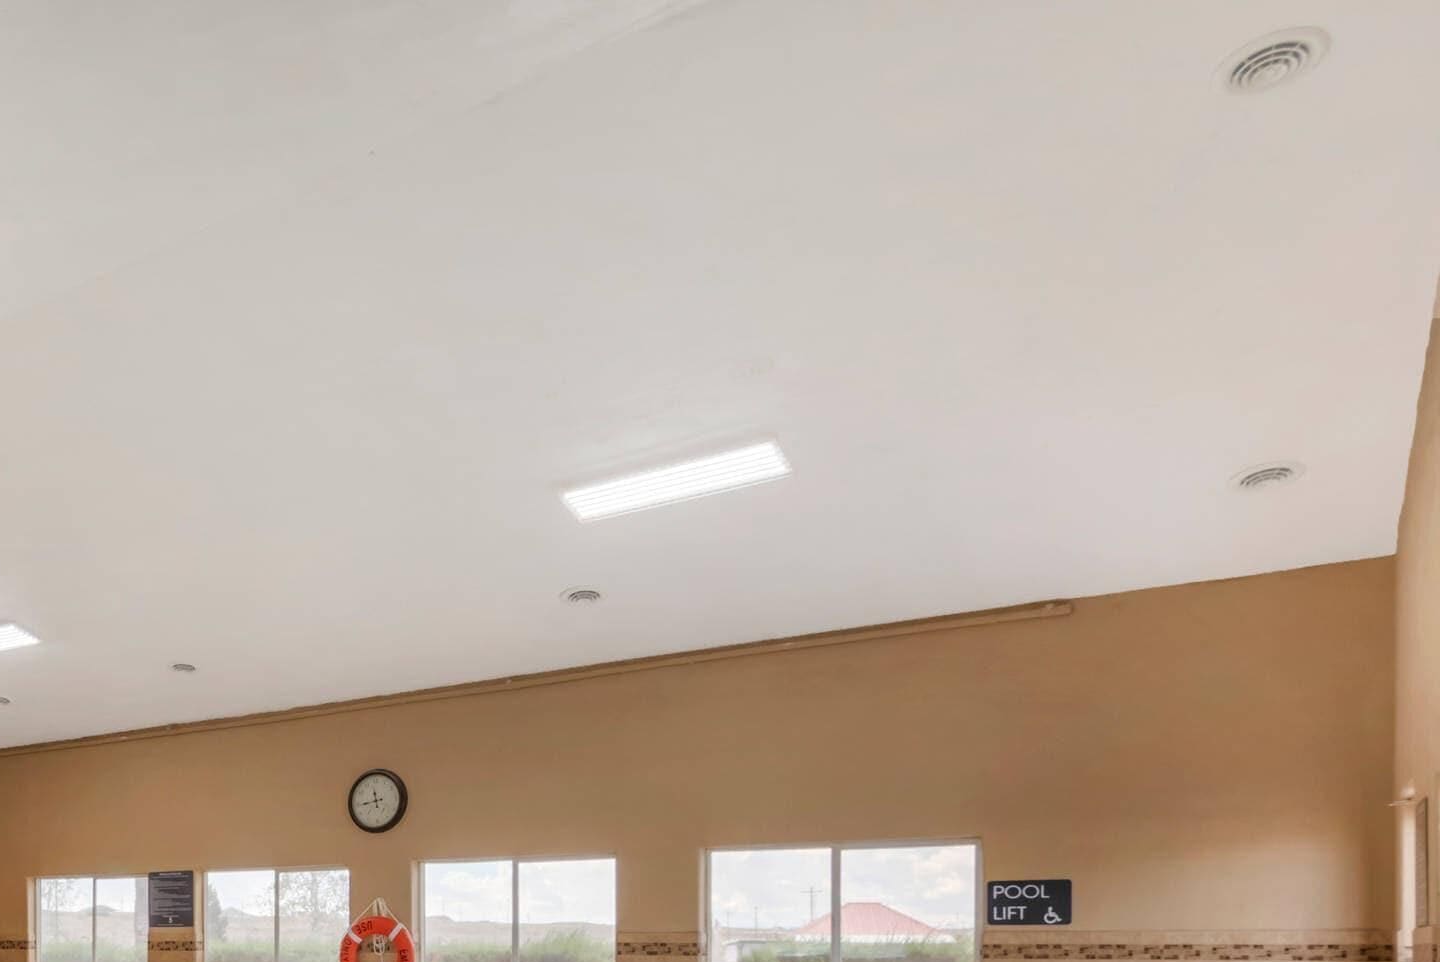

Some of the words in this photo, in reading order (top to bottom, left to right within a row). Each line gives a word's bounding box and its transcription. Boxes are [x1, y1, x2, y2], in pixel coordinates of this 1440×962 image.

[993, 884, 1050, 899] POOL
[993, 905, 1027, 920] LIFT
[356, 921, 373, 934] USE
[343, 940, 353, 961] ONLY
